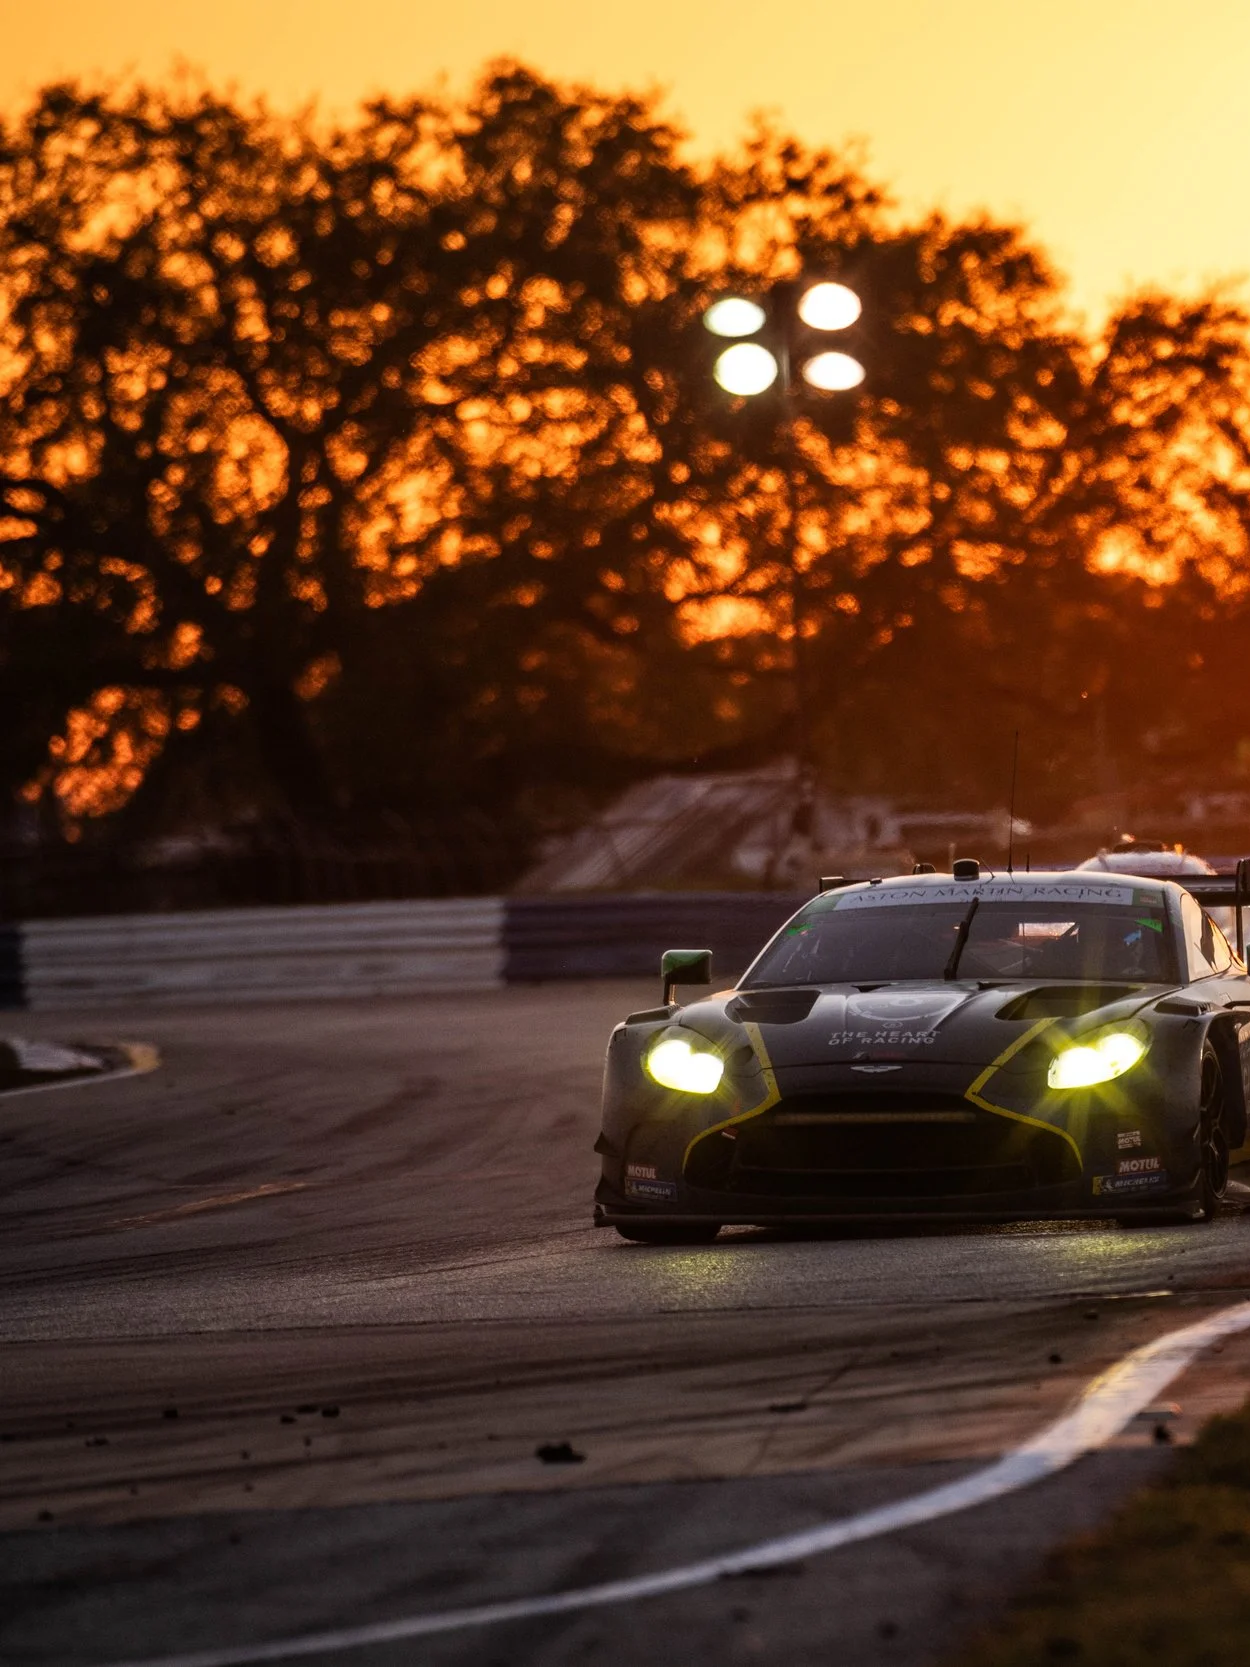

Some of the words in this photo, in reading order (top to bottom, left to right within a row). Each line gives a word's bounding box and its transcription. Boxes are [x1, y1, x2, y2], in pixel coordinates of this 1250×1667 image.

[854, 890, 926, 902] ASTON
[934, 886, 1024, 897] MARTIN
[1033, 886, 1122, 898] RACING
[831, 1030, 868, 1039] THE
[874, 1030, 942, 1038] HEART
[828, 1038, 855, 1046] OF
[860, 1037, 936, 1045] RACING
[627, 1164, 657, 1179] MOTUL
[1119, 1157, 1160, 1173] MOTUL
[1114, 1175, 1160, 1188] MICHELIN
[638, 1184, 672, 1196] MICHELIN
